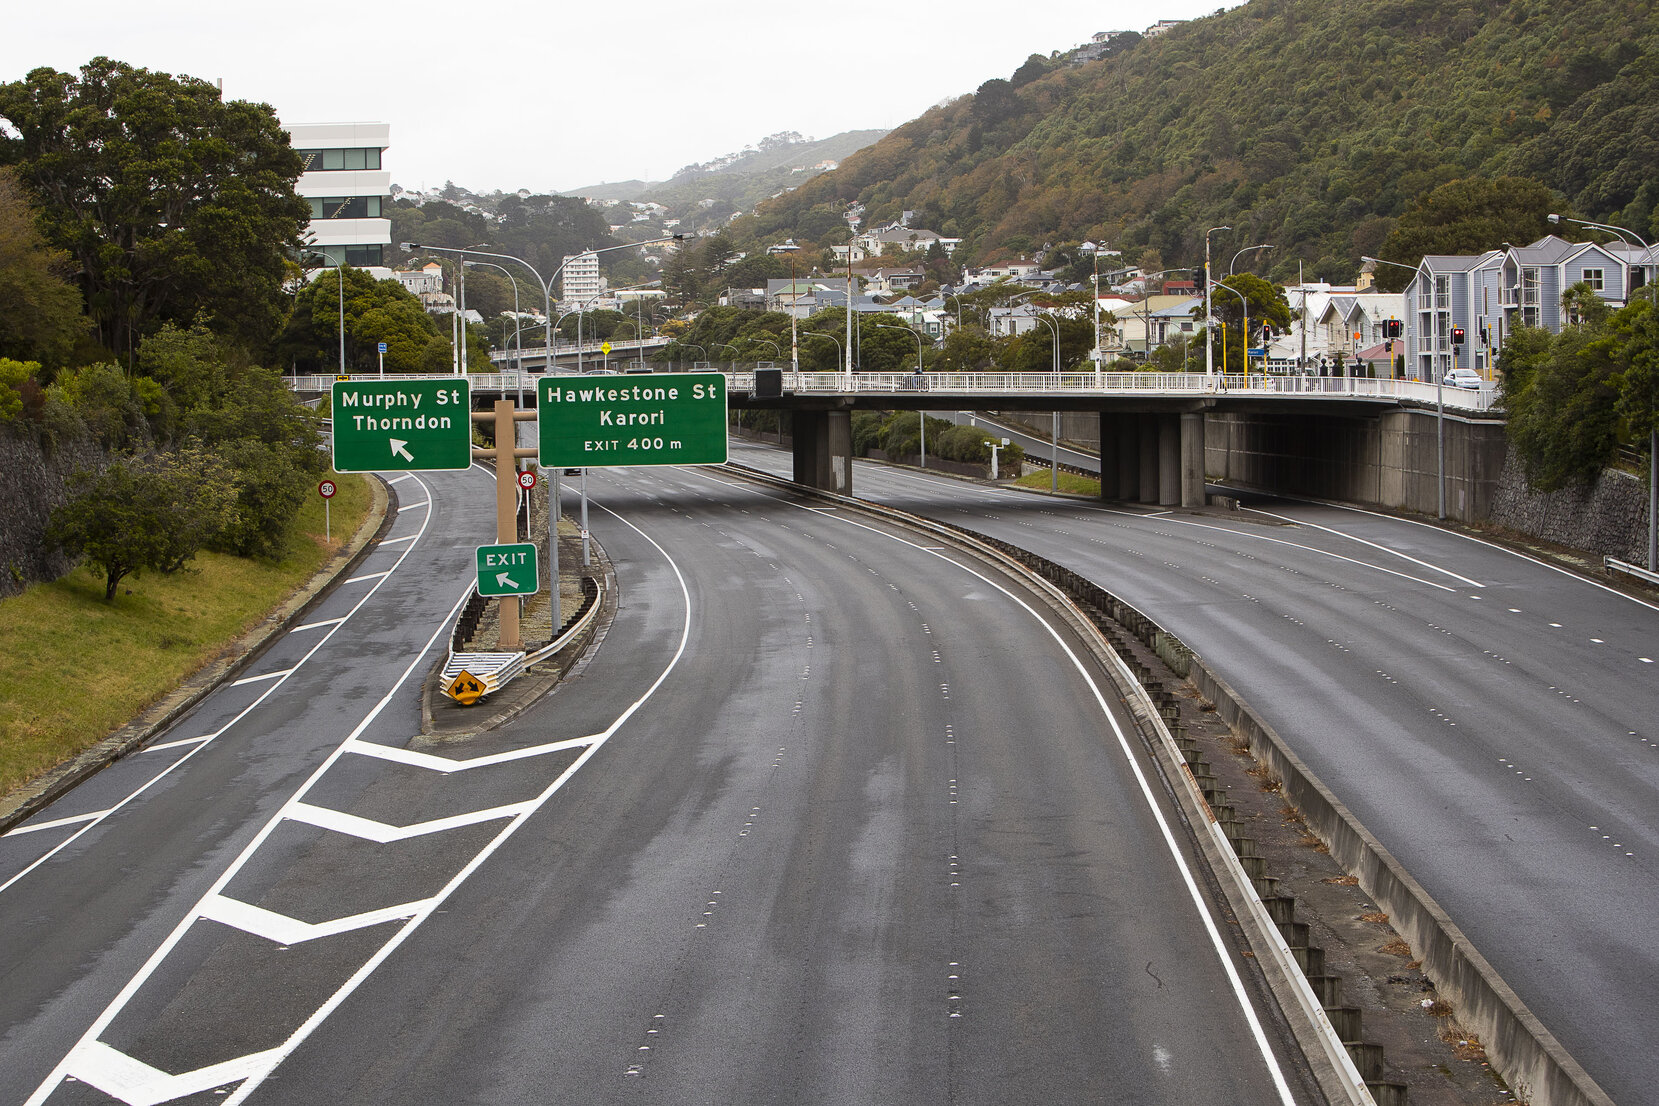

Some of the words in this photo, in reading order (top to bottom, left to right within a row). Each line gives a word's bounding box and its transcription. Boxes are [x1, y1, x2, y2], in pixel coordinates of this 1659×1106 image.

[342, 391, 423, 410] Murphy
[436, 389, 460, 405] St
[548, 385, 679, 403] Hawkestone
[692, 383, 716, 400] St
[353, 414, 451, 431] Thorndon
[600, 409, 664, 426] Karori
[584, 440, 619, 451] EXIT
[627, 438, 664, 450] 400
[670, 440, 682, 449] m
[522, 476, 533, 484] 50
[322, 485, 333, 493] 50
[486, 552, 527, 567] EXIT
